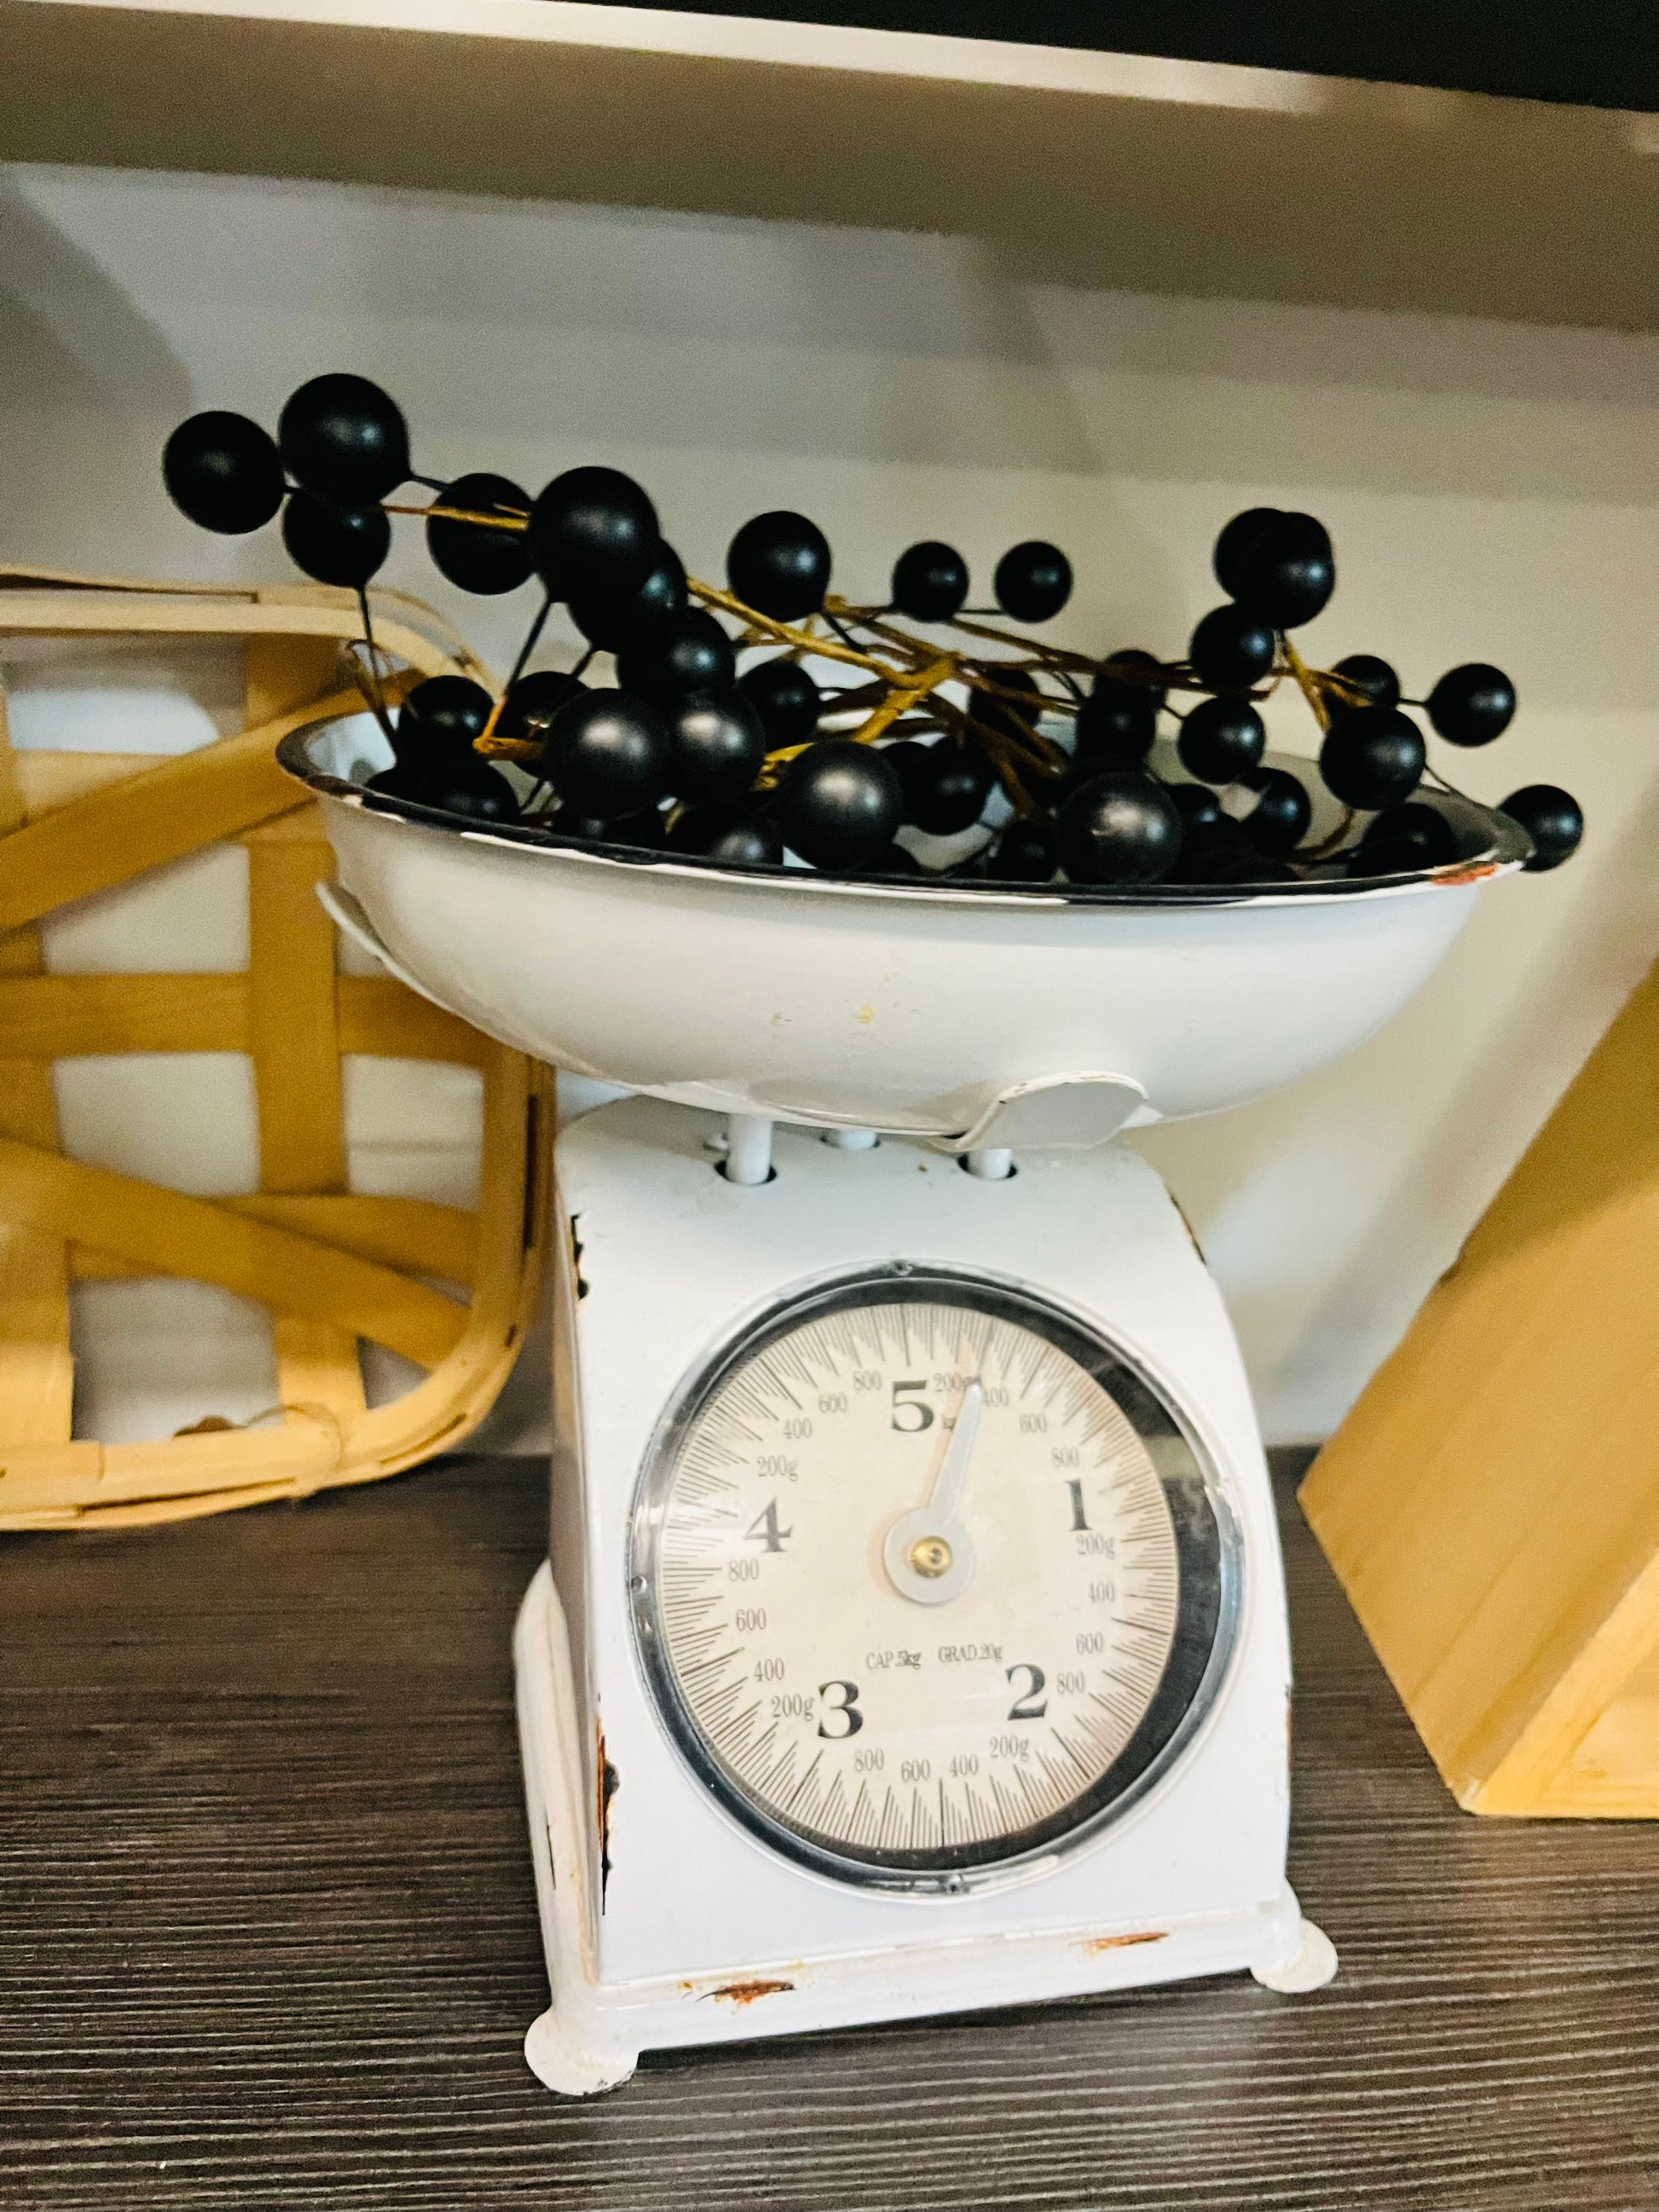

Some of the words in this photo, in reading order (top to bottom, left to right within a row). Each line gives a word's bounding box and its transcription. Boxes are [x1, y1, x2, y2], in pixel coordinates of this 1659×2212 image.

[852, 1371, 882, 1391] 800
[818, 1392, 848, 1414] 600
[892, 1380, 934, 1433] 5
[783, 1418, 813, 1441] 400
[1019, 1412, 1049, 1434] 600
[757, 1455, 799, 1481] 200g
[1051, 1446, 1079, 1468] 800
[1064, 1478, 1093, 1533] 1
[743, 1496, 795, 1553] 4
[1076, 1533, 1116, 1560] 200g
[729, 1557, 760, 1581] 800
[1088, 1580, 1116, 1603] 400
[736, 1607, 767, 1632] 600
[1075, 1632, 1105, 1655] 600
[754, 1657, 785, 1683] 400
[1004, 1663, 1049, 1721] 2
[1056, 1672, 1085, 1695] 800
[771, 1693, 816, 1722] 200g
[817, 1680, 864, 1740] 3
[853, 1748, 885, 1772] 800
[989, 1734, 1030, 1762] 200g
[900, 1759, 931, 1782] 600
[949, 1753, 979, 1777] 400
